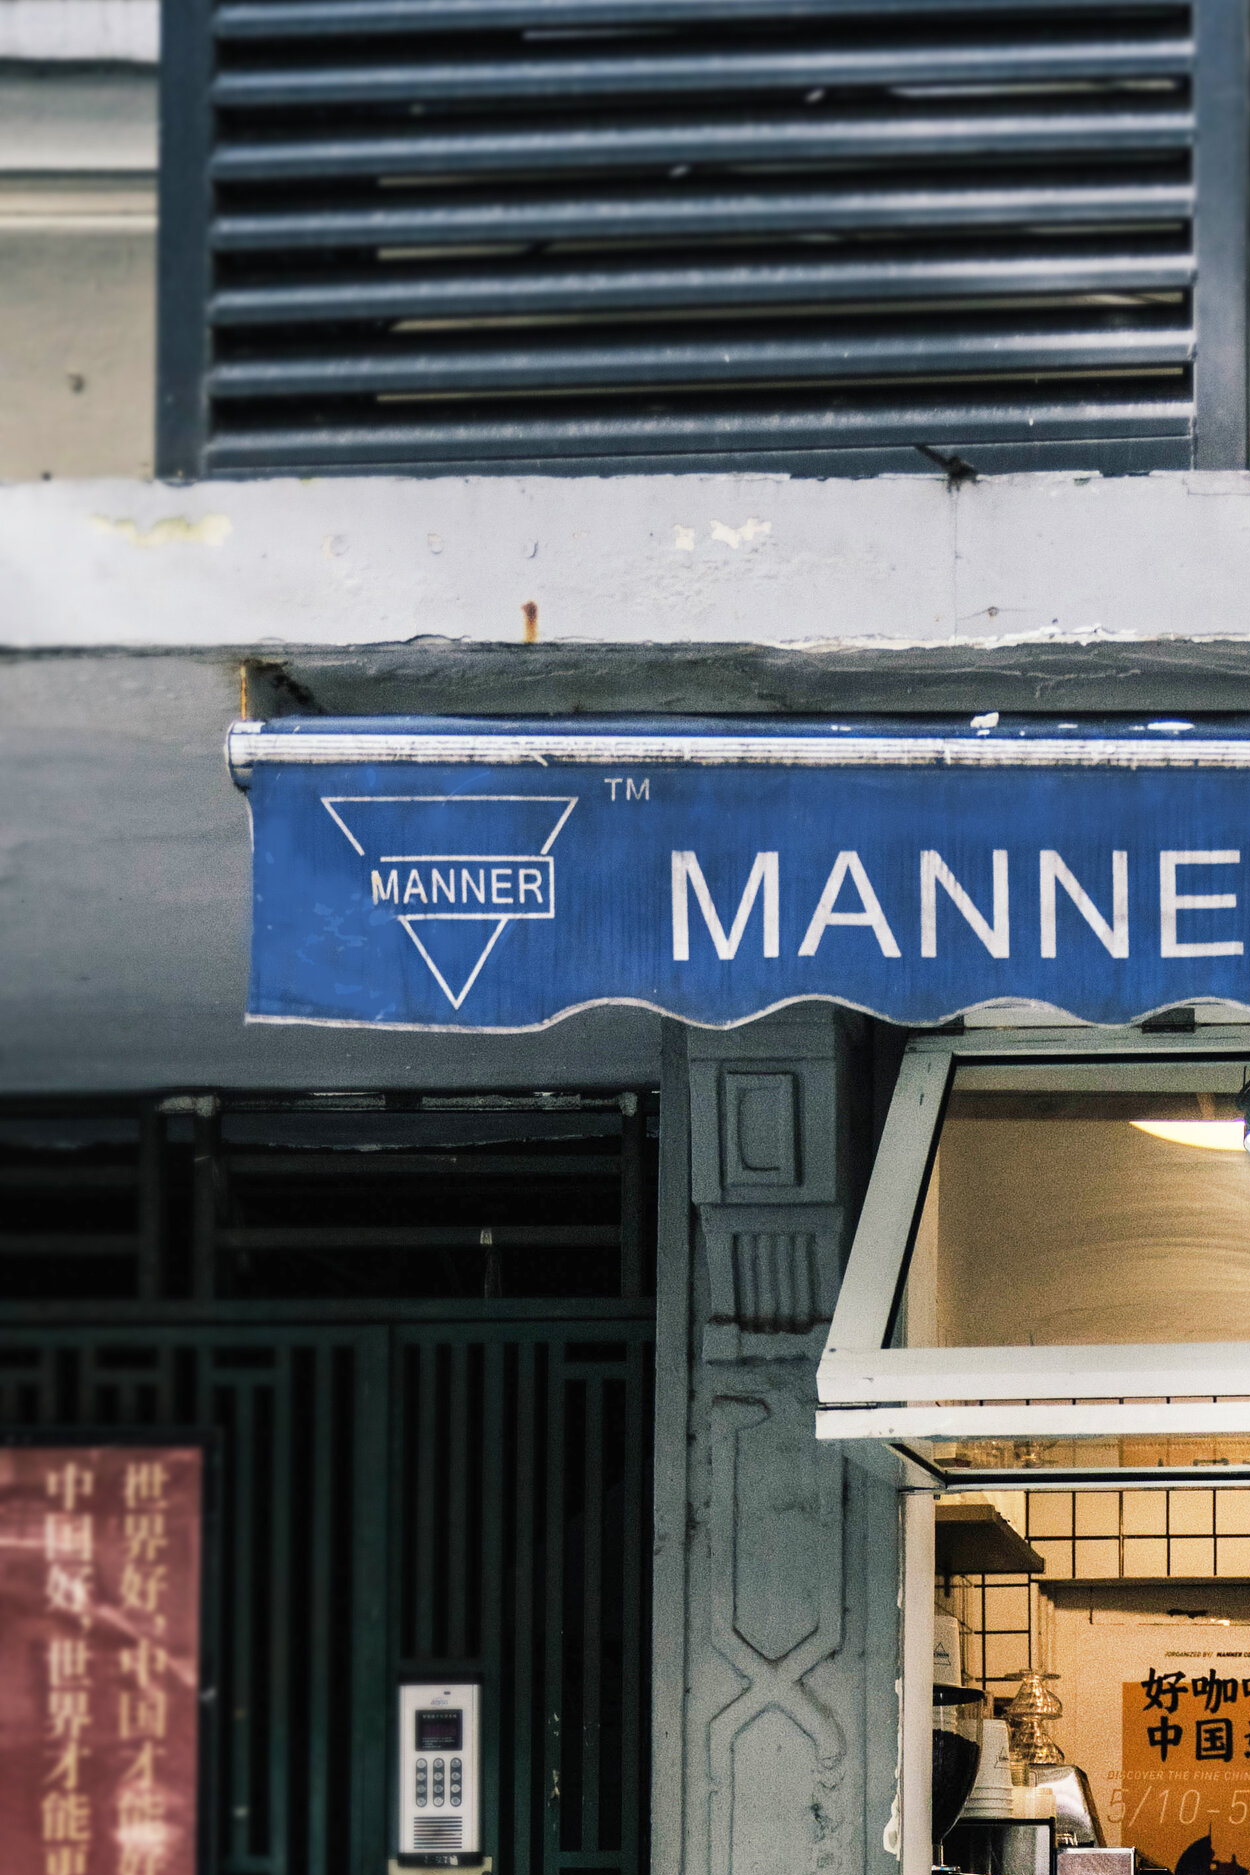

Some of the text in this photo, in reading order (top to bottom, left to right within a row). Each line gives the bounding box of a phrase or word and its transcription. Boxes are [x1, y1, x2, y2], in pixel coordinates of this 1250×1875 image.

[605, 778, 651, 801] TM
[372, 870, 544, 905] MANNER
[1107, 1770, 1164, 1780] DISCOVER
[1168, 1770, 1189, 1780] THE
[1194, 1770, 1219, 1781] FINE
